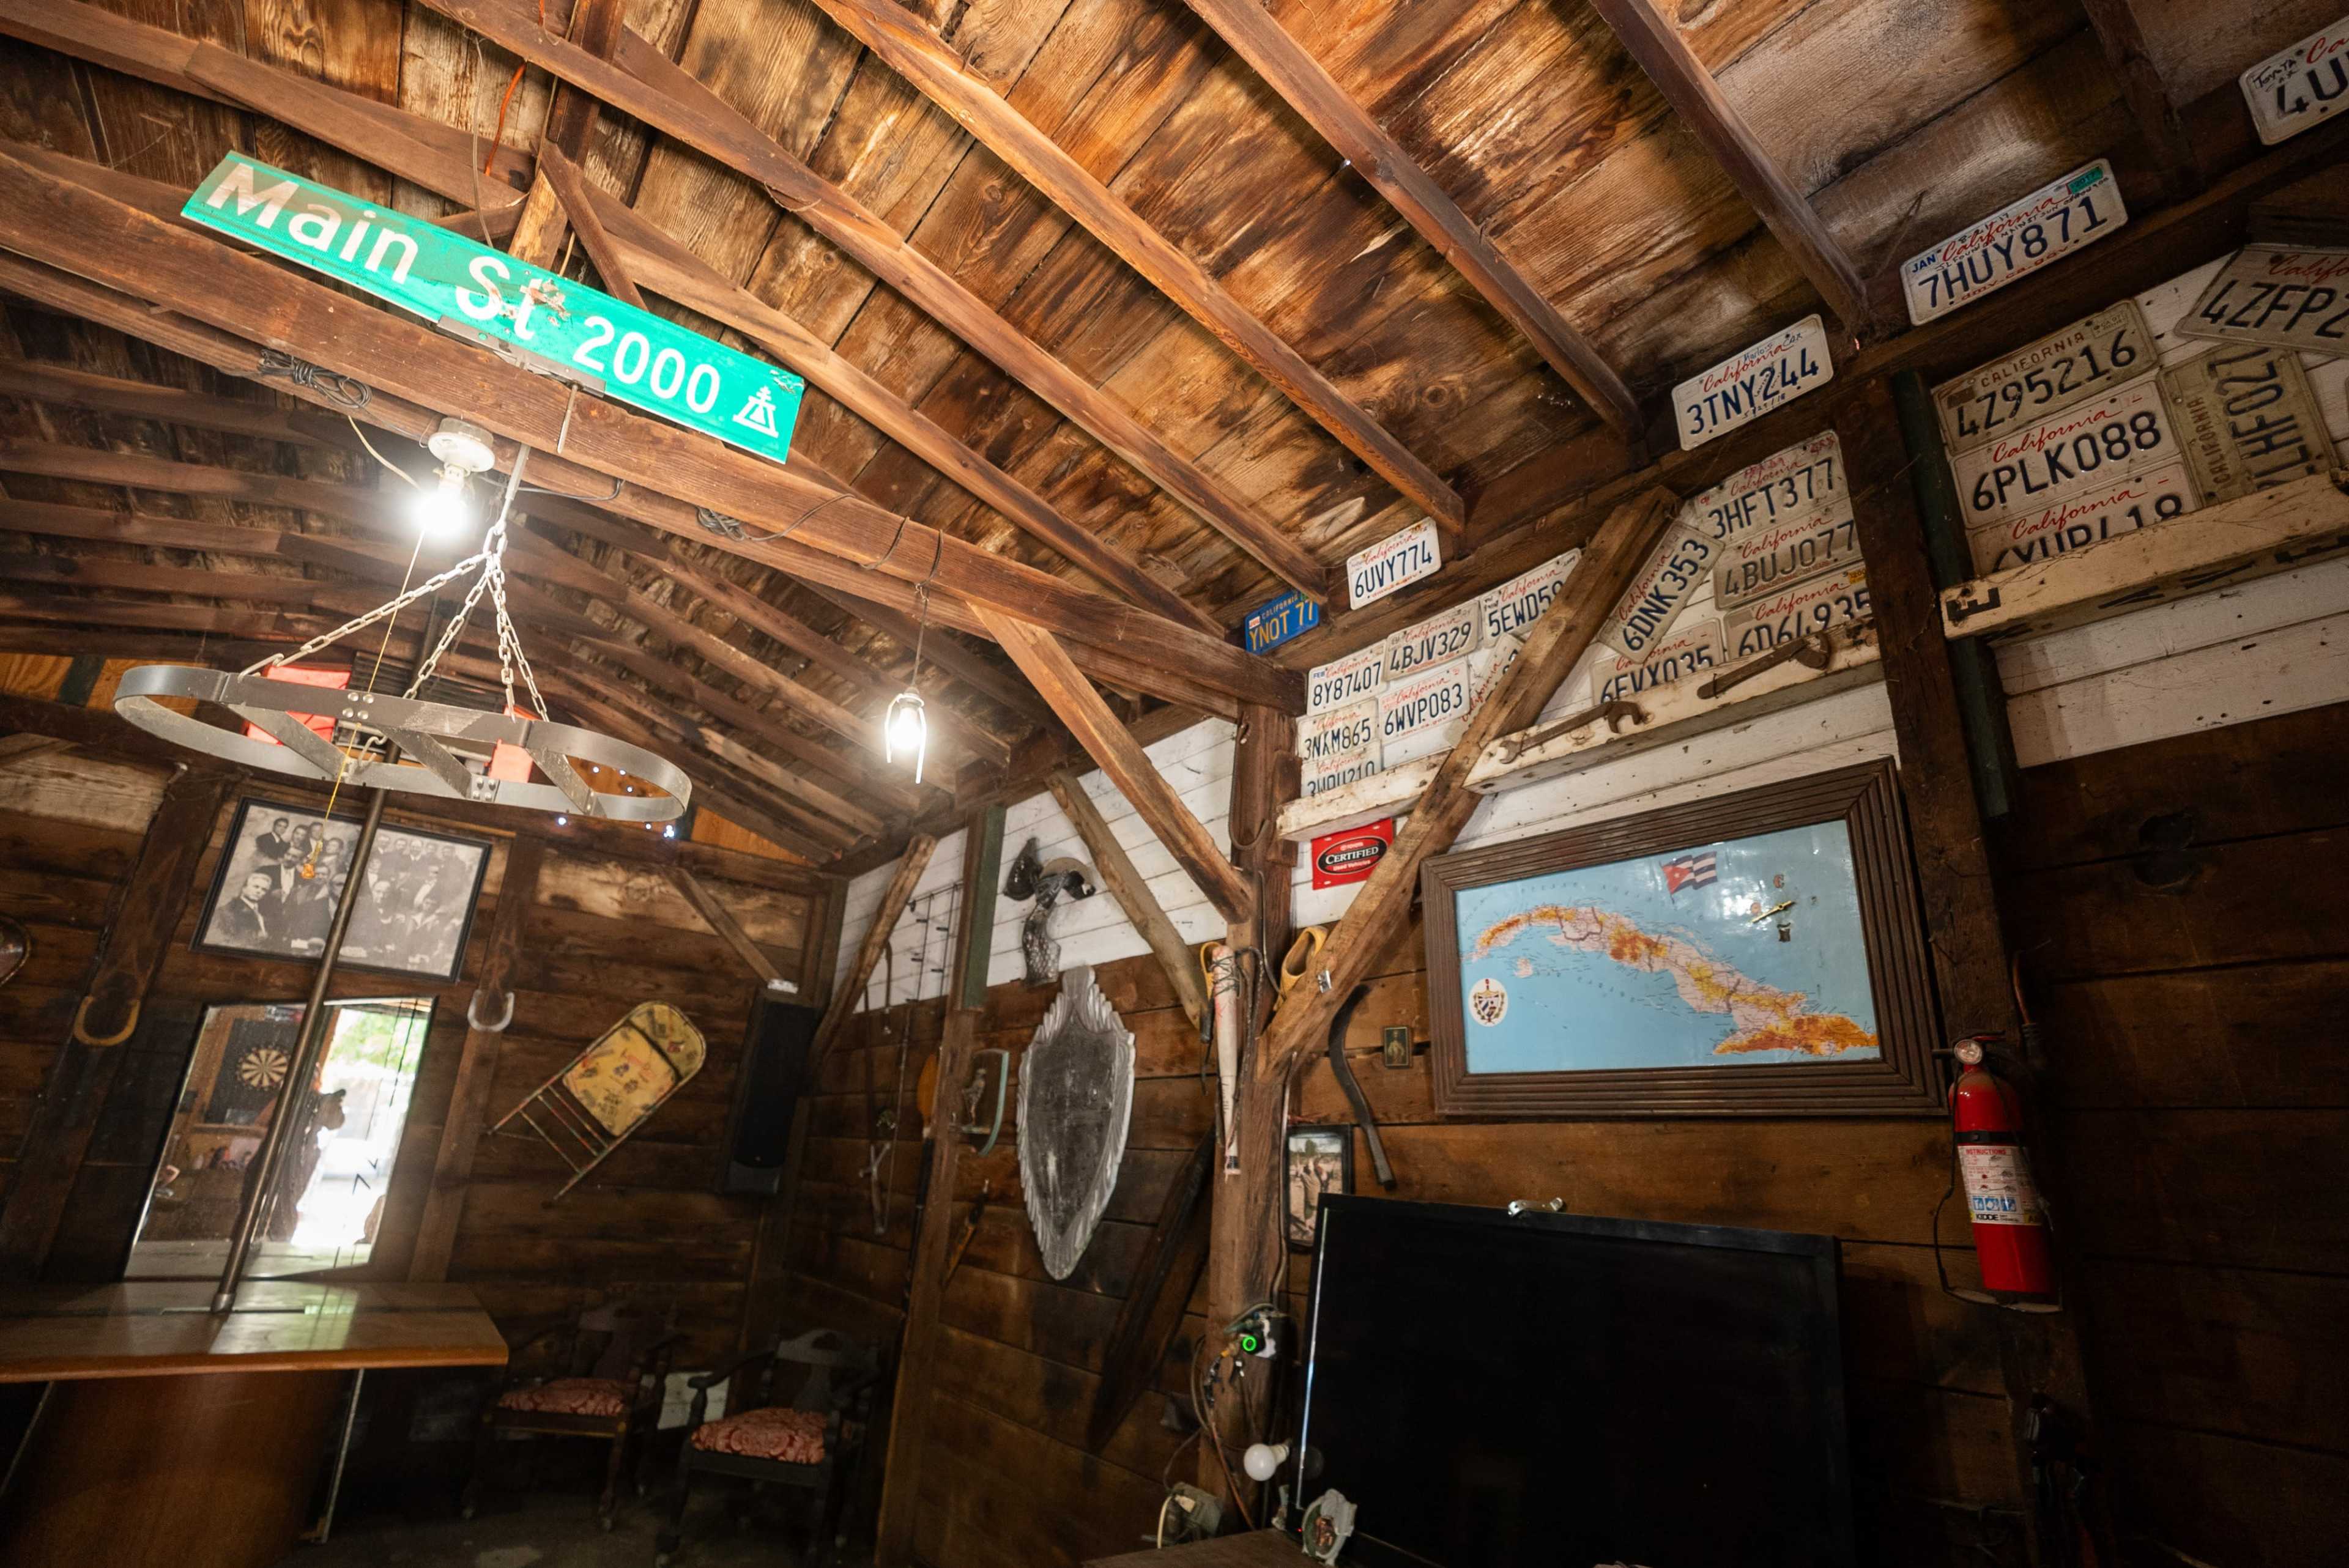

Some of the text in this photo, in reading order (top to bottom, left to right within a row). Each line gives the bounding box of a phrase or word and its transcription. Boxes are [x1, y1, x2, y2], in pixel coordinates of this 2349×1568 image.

[2276, 50, 2349, 116] 4U
[1918, 196, 2108, 308] 7HUY871
[1942, 196, 2071, 262] California
[206, 163, 721, 414] Main St 2000
[1912, 254, 1937, 273] JAN
[1961, 246, 2068, 301] dmv.ca.gov
[1703, 344, 1794, 393] California
[1958, 329, 2136, 437] 4Z95216
[1981, 331, 2085, 388] CALIFORNIA
[1687, 347, 1819, 435] 3TNY244
[1993, 409, 2123, 463] California
[2186, 398, 2231, 484] CALIFORNIA
[2207, 347, 2310, 489] LHF027
[1730, 461, 1806, 497] California
[1973, 410, 2161, 511] 6PLK088
[1709, 456, 1833, 539] 3HFT377
[2012, 488, 2148, 541] California
[1724, 519, 1855, 596] 4BUJ077
[1742, 516, 1835, 559] California
[1355, 540, 1432, 598] 6UVY774
[1501, 569, 1563, 603] California
[1619, 549, 1675, 621] California
[1624, 539, 1709, 651] 6DNK353
[1756, 582, 1852, 621] California
[1249, 610, 1290, 651] YNOT
[1390, 621, 1472, 671] 4BJV329
[1405, 617, 1462, 643] California
[1616, 639, 1695, 671] Caornia
[1313, 656, 1372, 679] FEB California
[1313, 661, 1381, 706] 8Y87407
[1396, 677, 1450, 704] California
[1316, 711, 1362, 731] California
[1384, 683, 1463, 736] 6WVP083
[1304, 718, 1371, 761] 3NKM865
[1318, 753, 1367, 774] California
[1325, 846, 1379, 865] CERTIFIED
